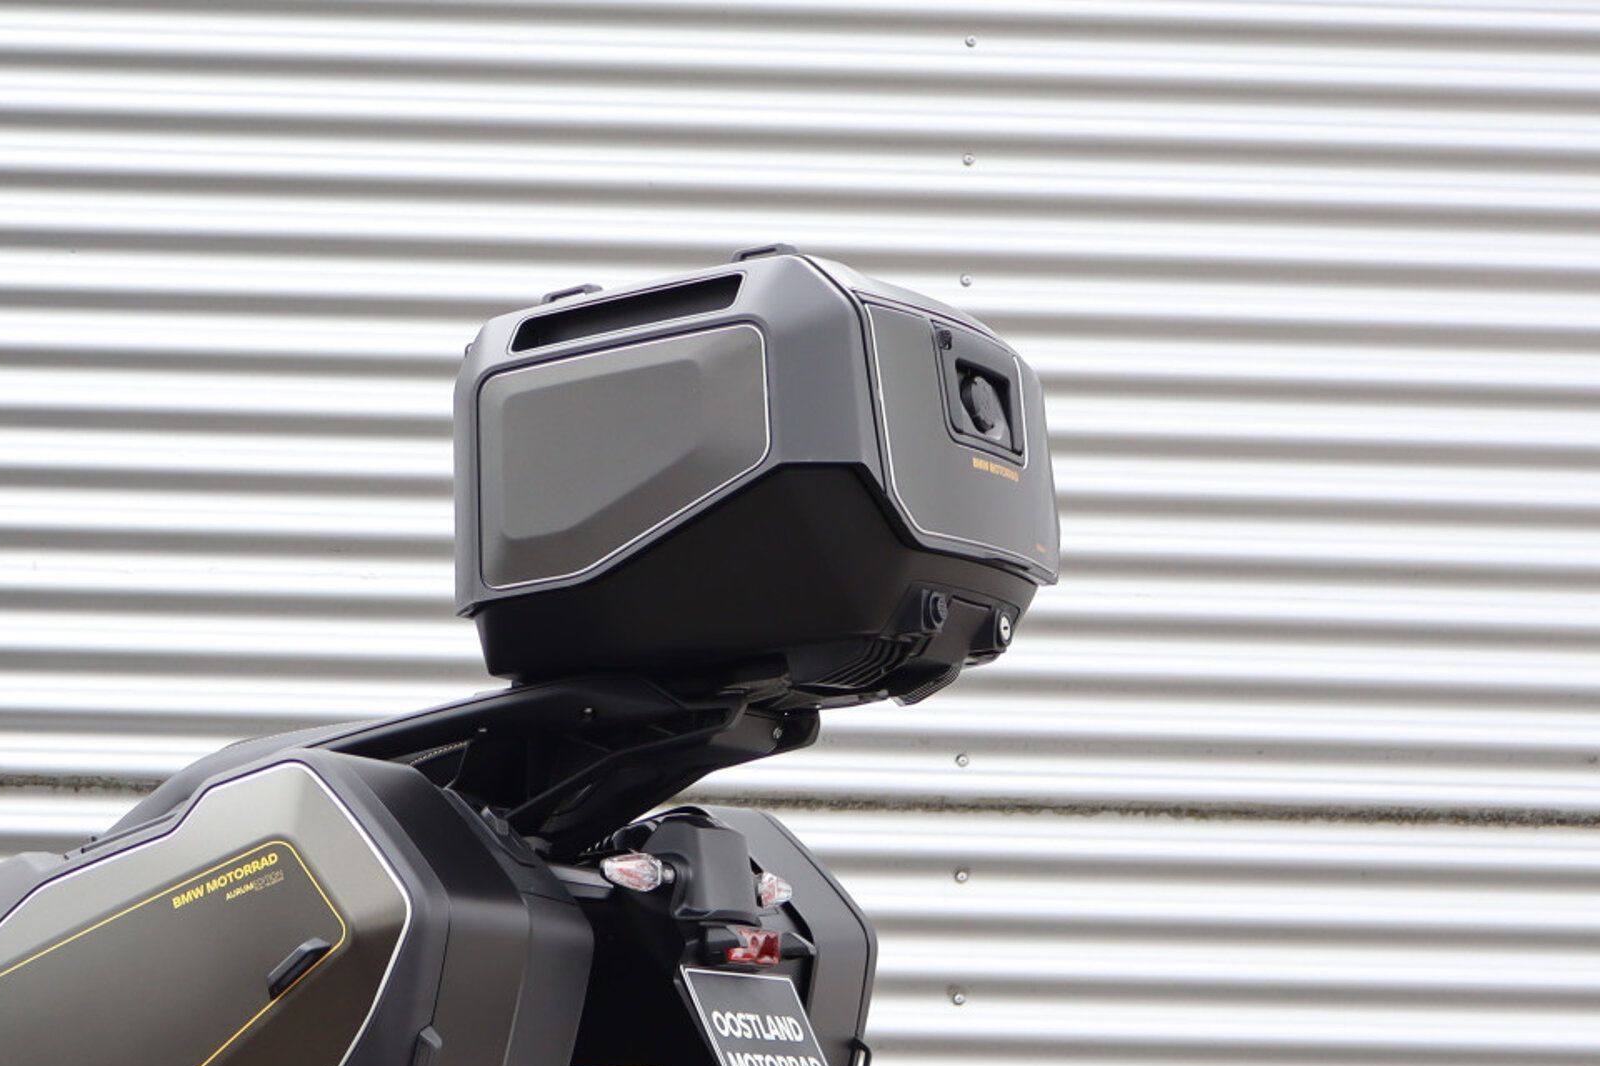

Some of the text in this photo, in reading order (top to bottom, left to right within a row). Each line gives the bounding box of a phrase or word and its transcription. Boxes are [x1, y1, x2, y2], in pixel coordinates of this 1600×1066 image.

[171, 852, 278, 909] BMW MOTORRAD
[711, 1010, 805, 1042] OOSTLAND
